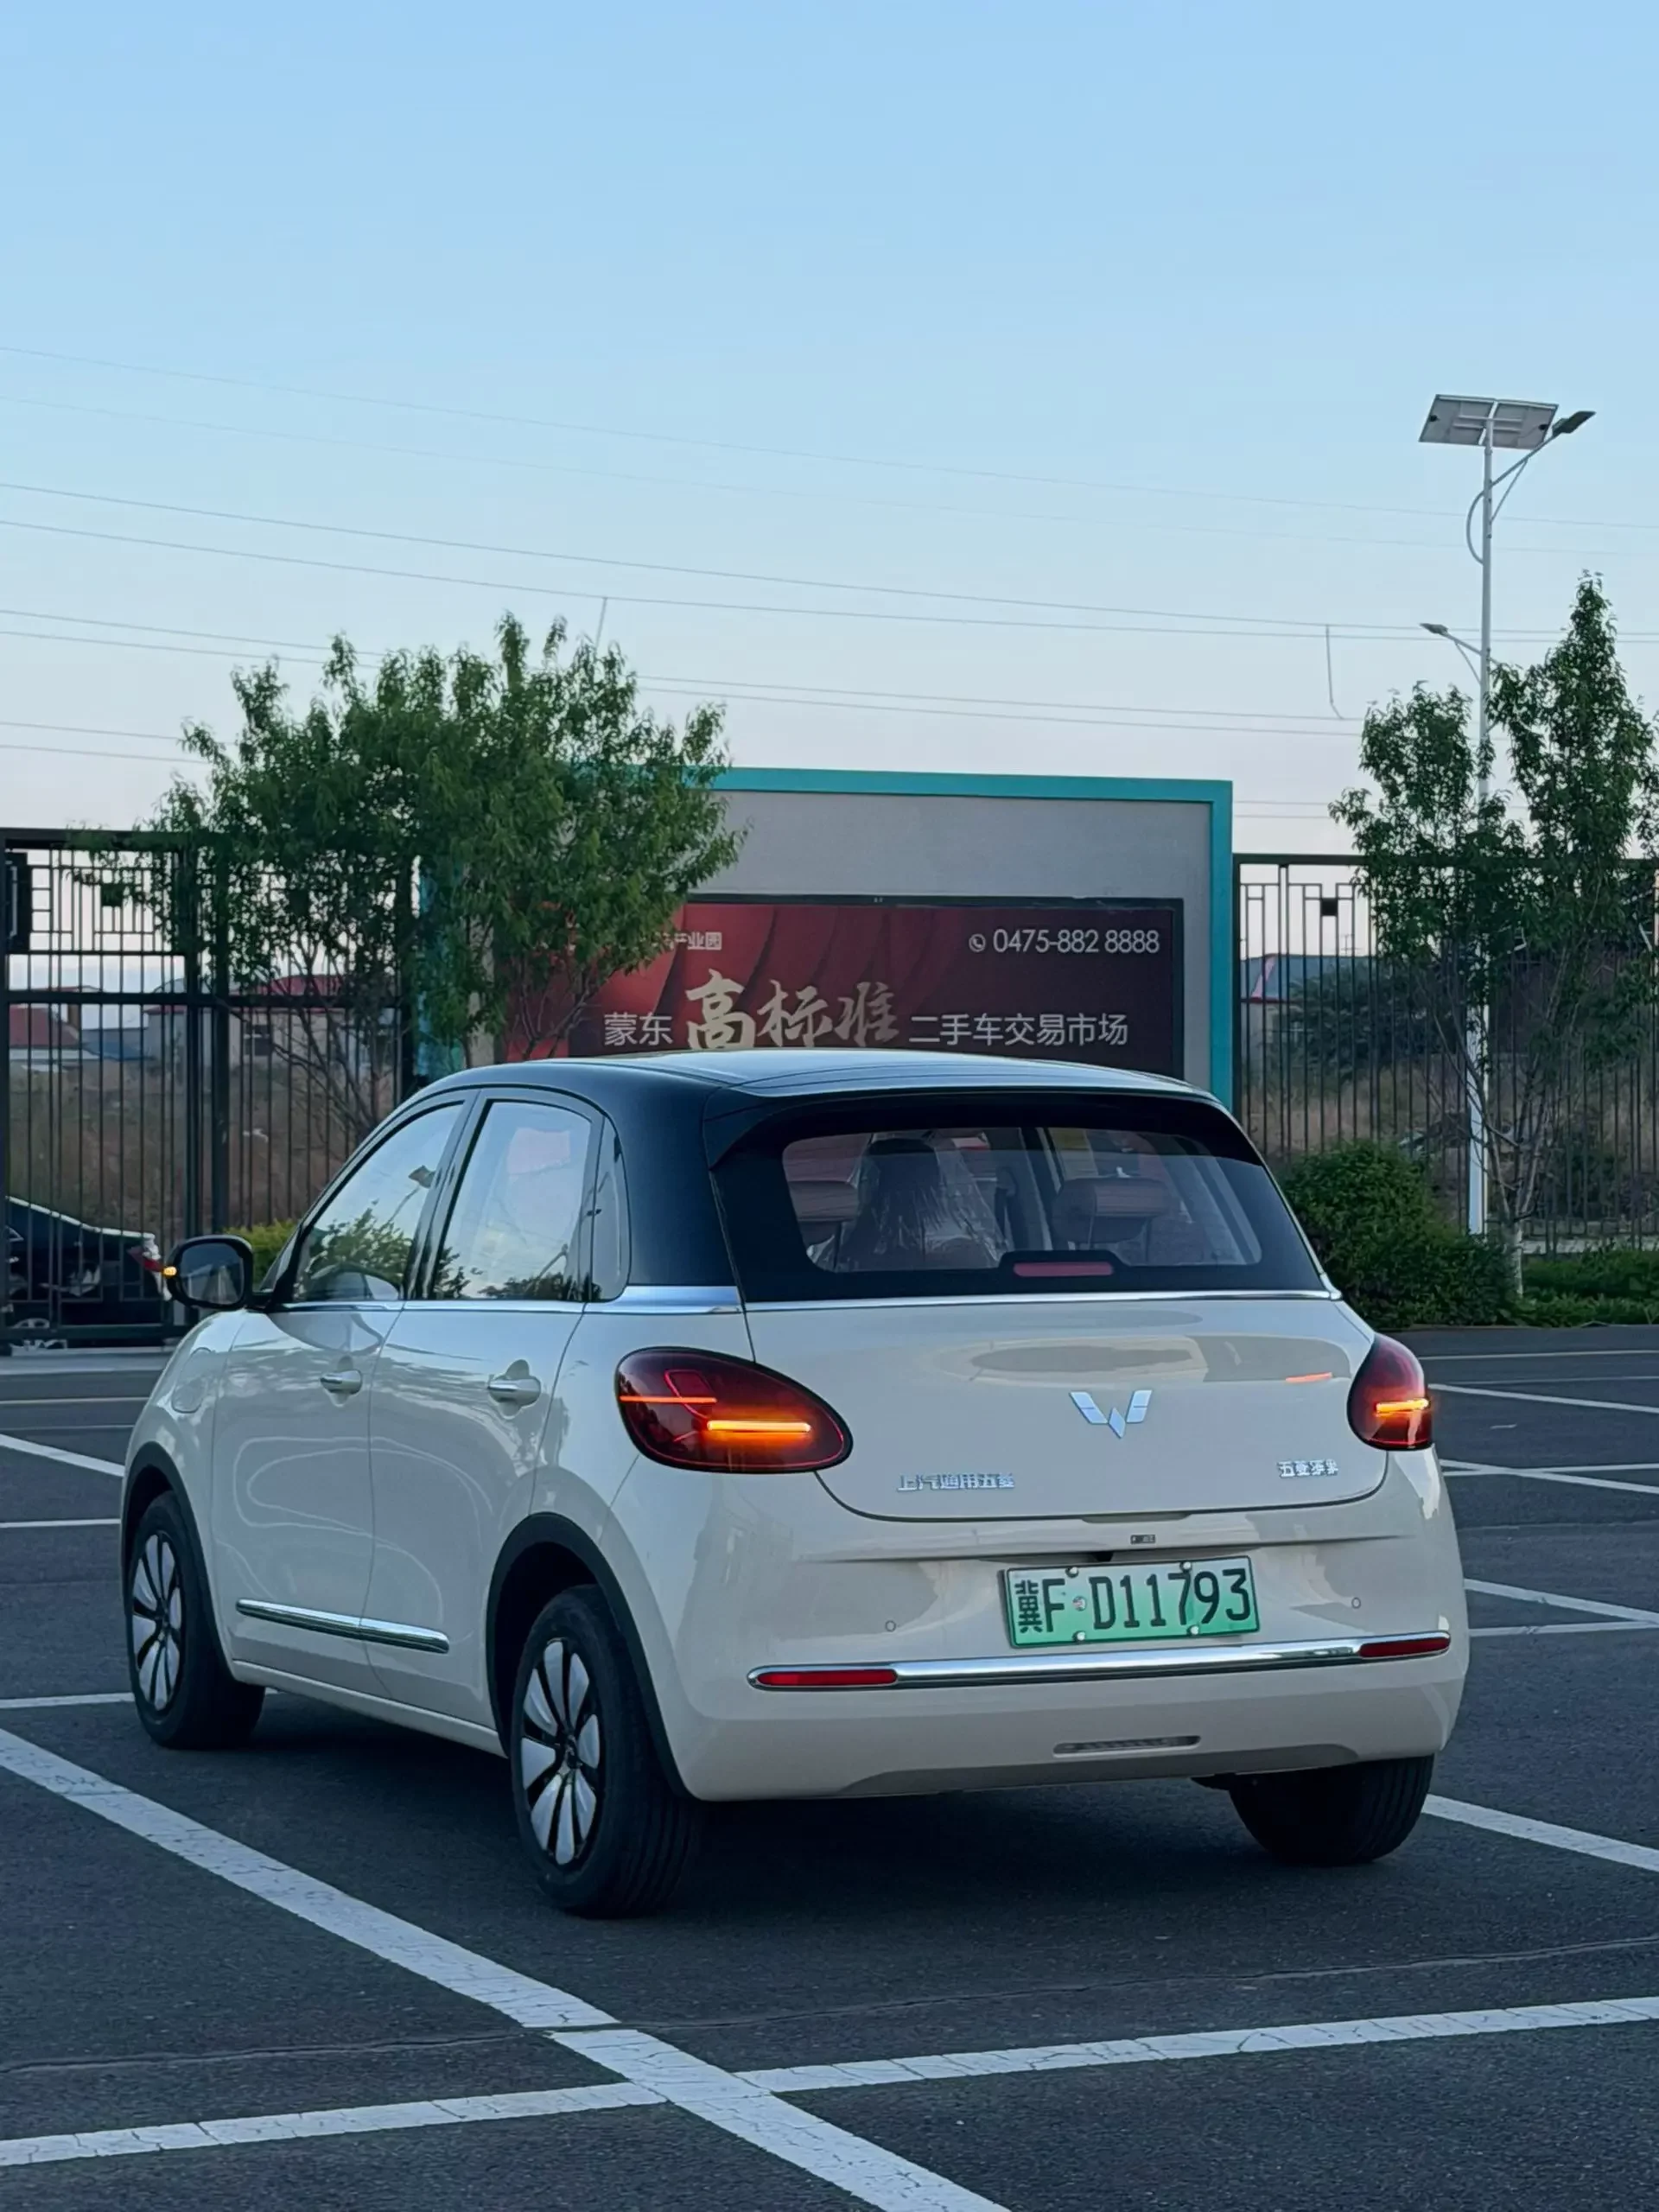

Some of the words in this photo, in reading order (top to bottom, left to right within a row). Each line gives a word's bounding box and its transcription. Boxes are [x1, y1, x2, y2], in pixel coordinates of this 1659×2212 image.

[1103, 929, 1160, 953] 8888
[603, 1012, 673, 1047] 蒙东
[908, 1013, 1128, 1047] 二手车交易市场
